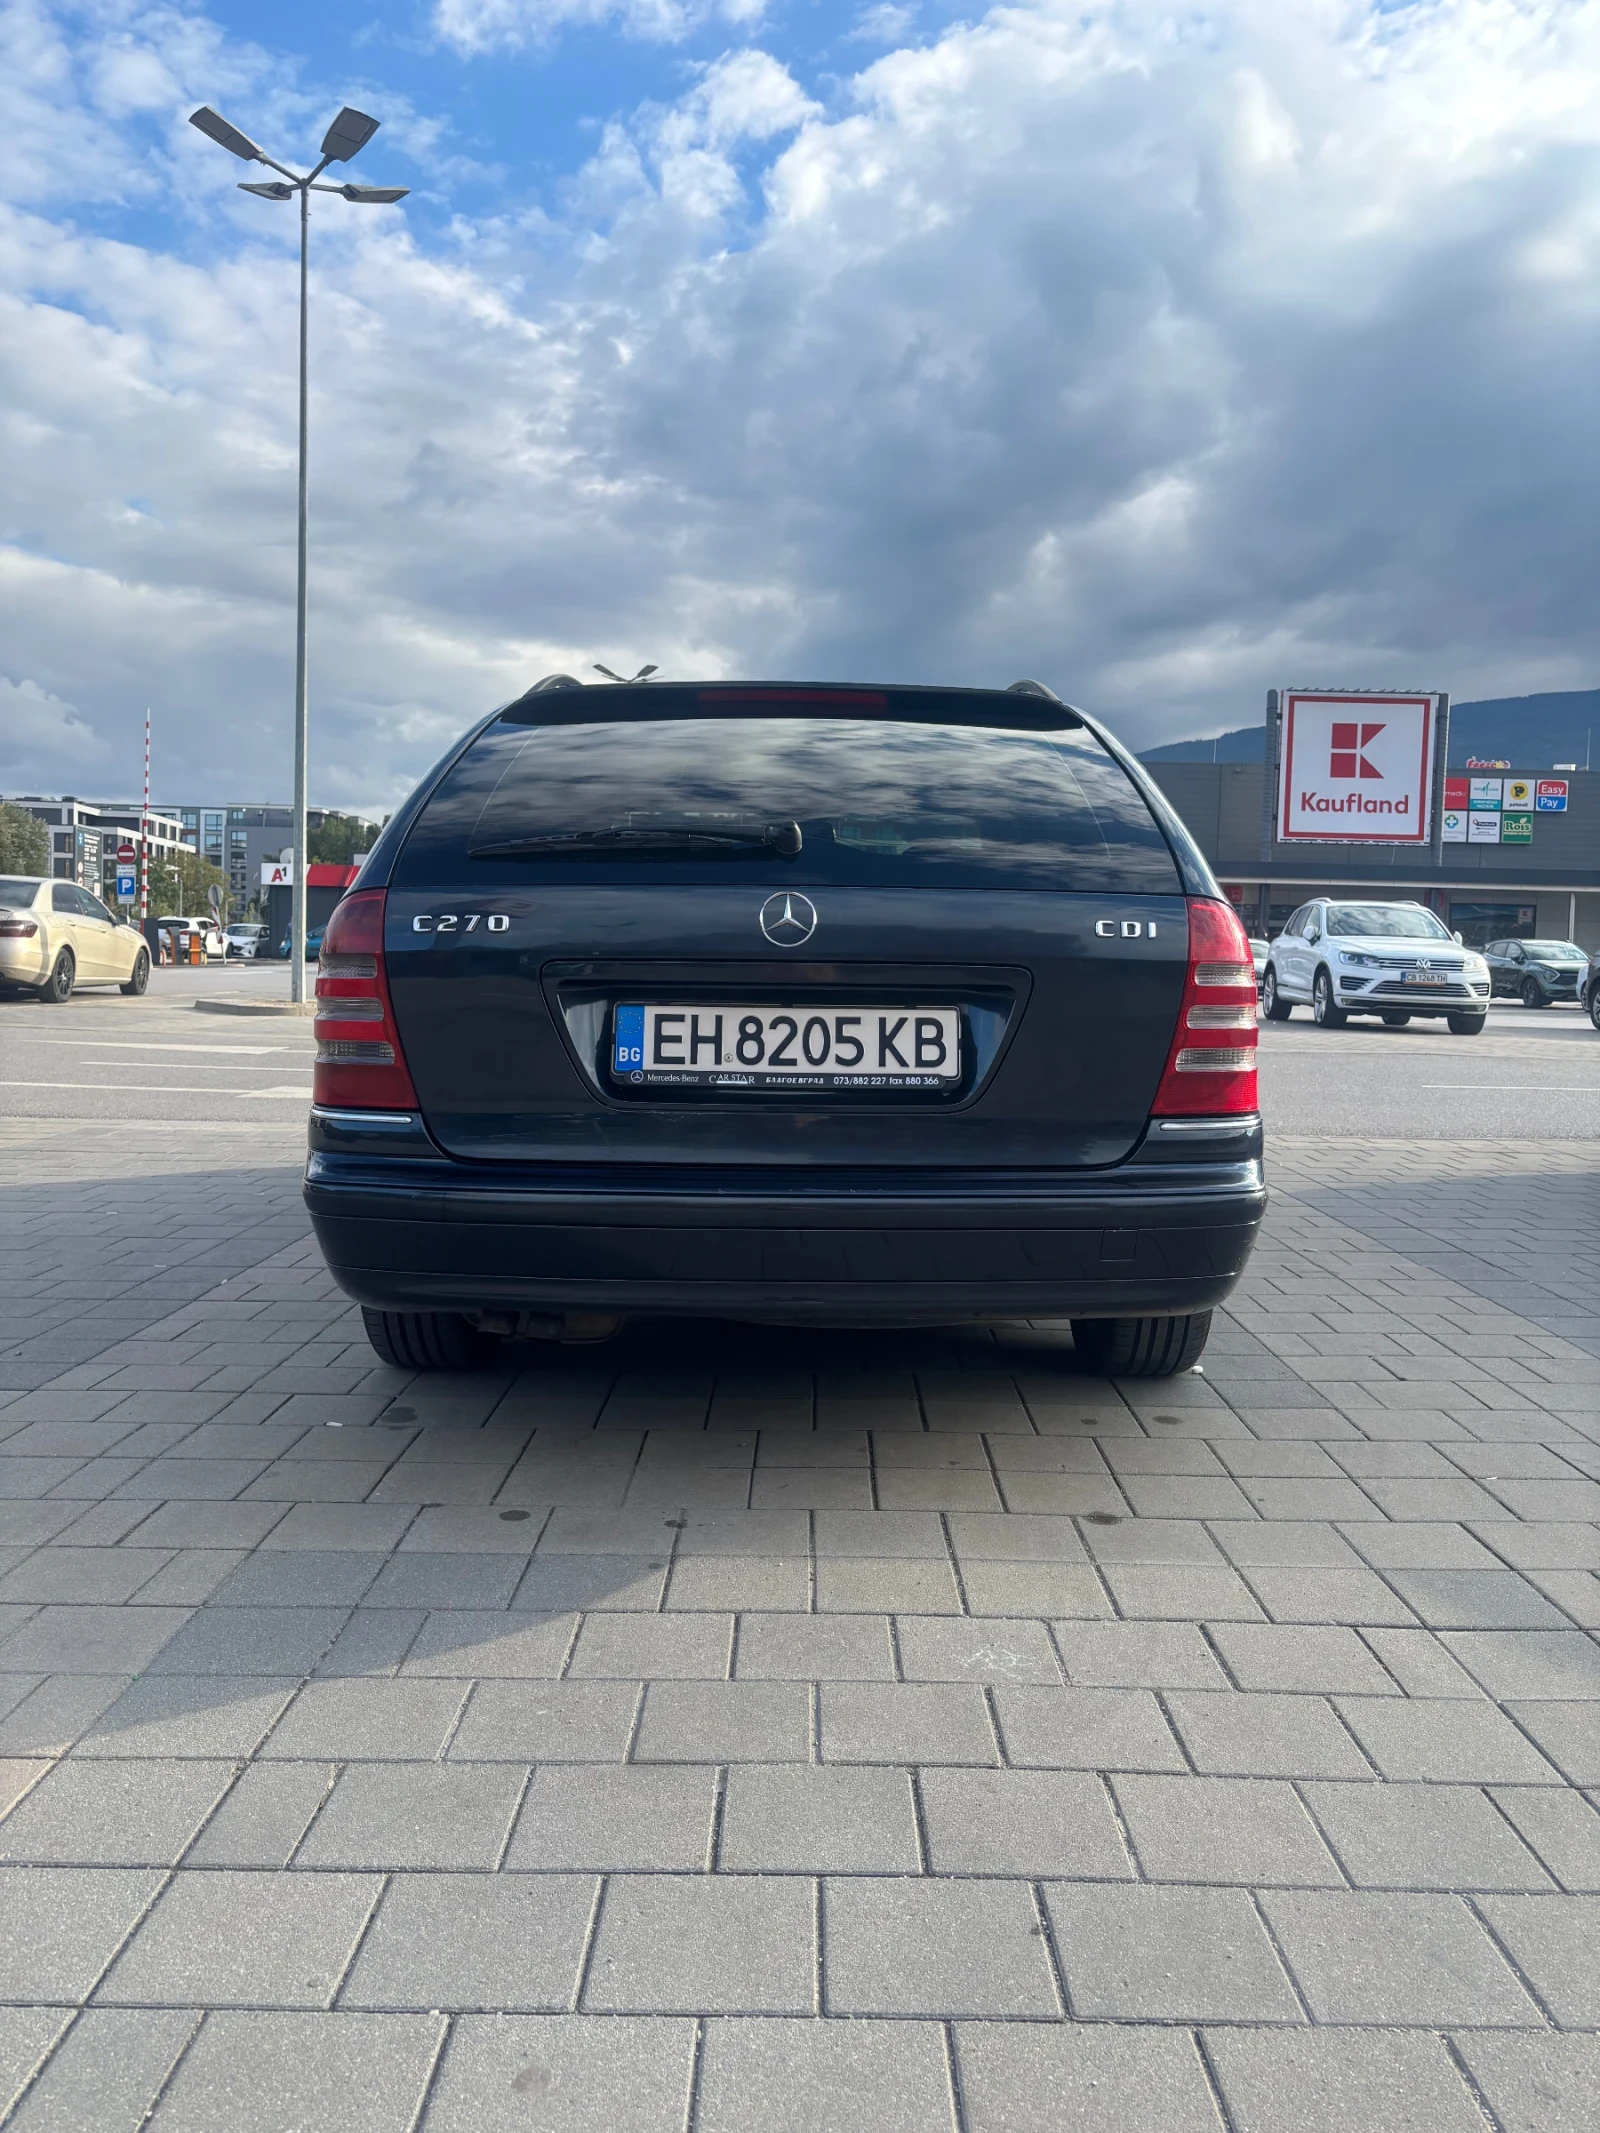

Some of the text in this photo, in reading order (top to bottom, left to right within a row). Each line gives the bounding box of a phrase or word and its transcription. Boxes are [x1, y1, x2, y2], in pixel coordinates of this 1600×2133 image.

[1541, 784, 1564, 796] Easy
[1301, 791, 1409, 814] Kaufland
[1540, 797, 1558, 808] Pay
[271, 866, 287, 882] A1
[121, 879, 132, 893] P
[412, 915, 510, 932] C270
[1095, 920, 1157, 938] CDI
[653, 1014, 947, 1068] EH 8205 KB
[618, 1047, 641, 1062] BG
[647, 1073, 700, 1083] Mercedes-Benz
[766, 1076, 824, 1084] БЛАГОЕВГРАД
[833, 1076, 939, 1086] 073/882 227 fax 880 366
